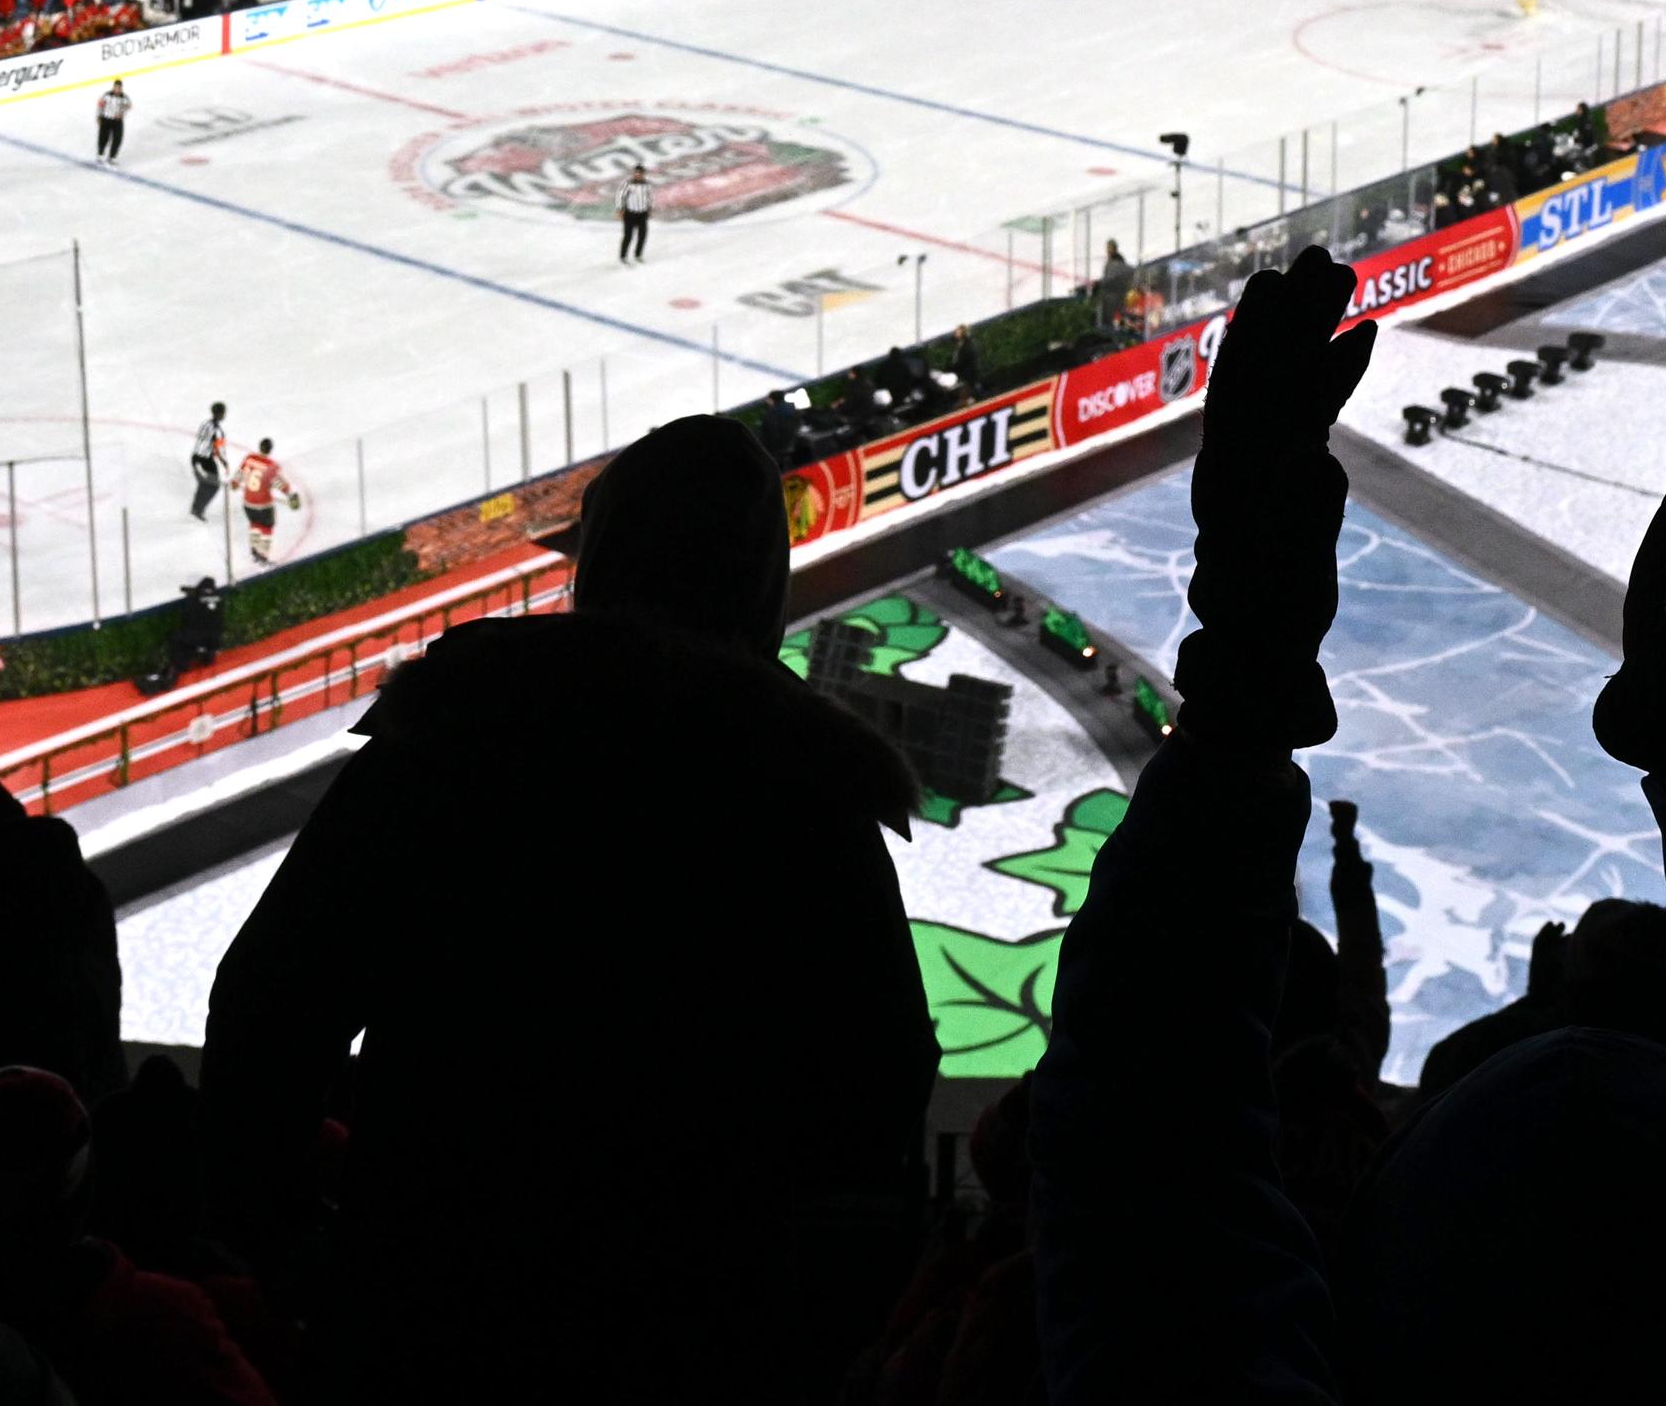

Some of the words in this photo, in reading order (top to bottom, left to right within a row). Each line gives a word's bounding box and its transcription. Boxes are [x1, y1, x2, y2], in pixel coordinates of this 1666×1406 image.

[99, 24, 201, 63] BODYARMOR
[1537, 178, 1614, 250] STL
[1345, 257, 1433, 319] LASSIC
[1076, 371, 1157, 423] DISCOVER
[899, 407, 1014, 499] CHI
